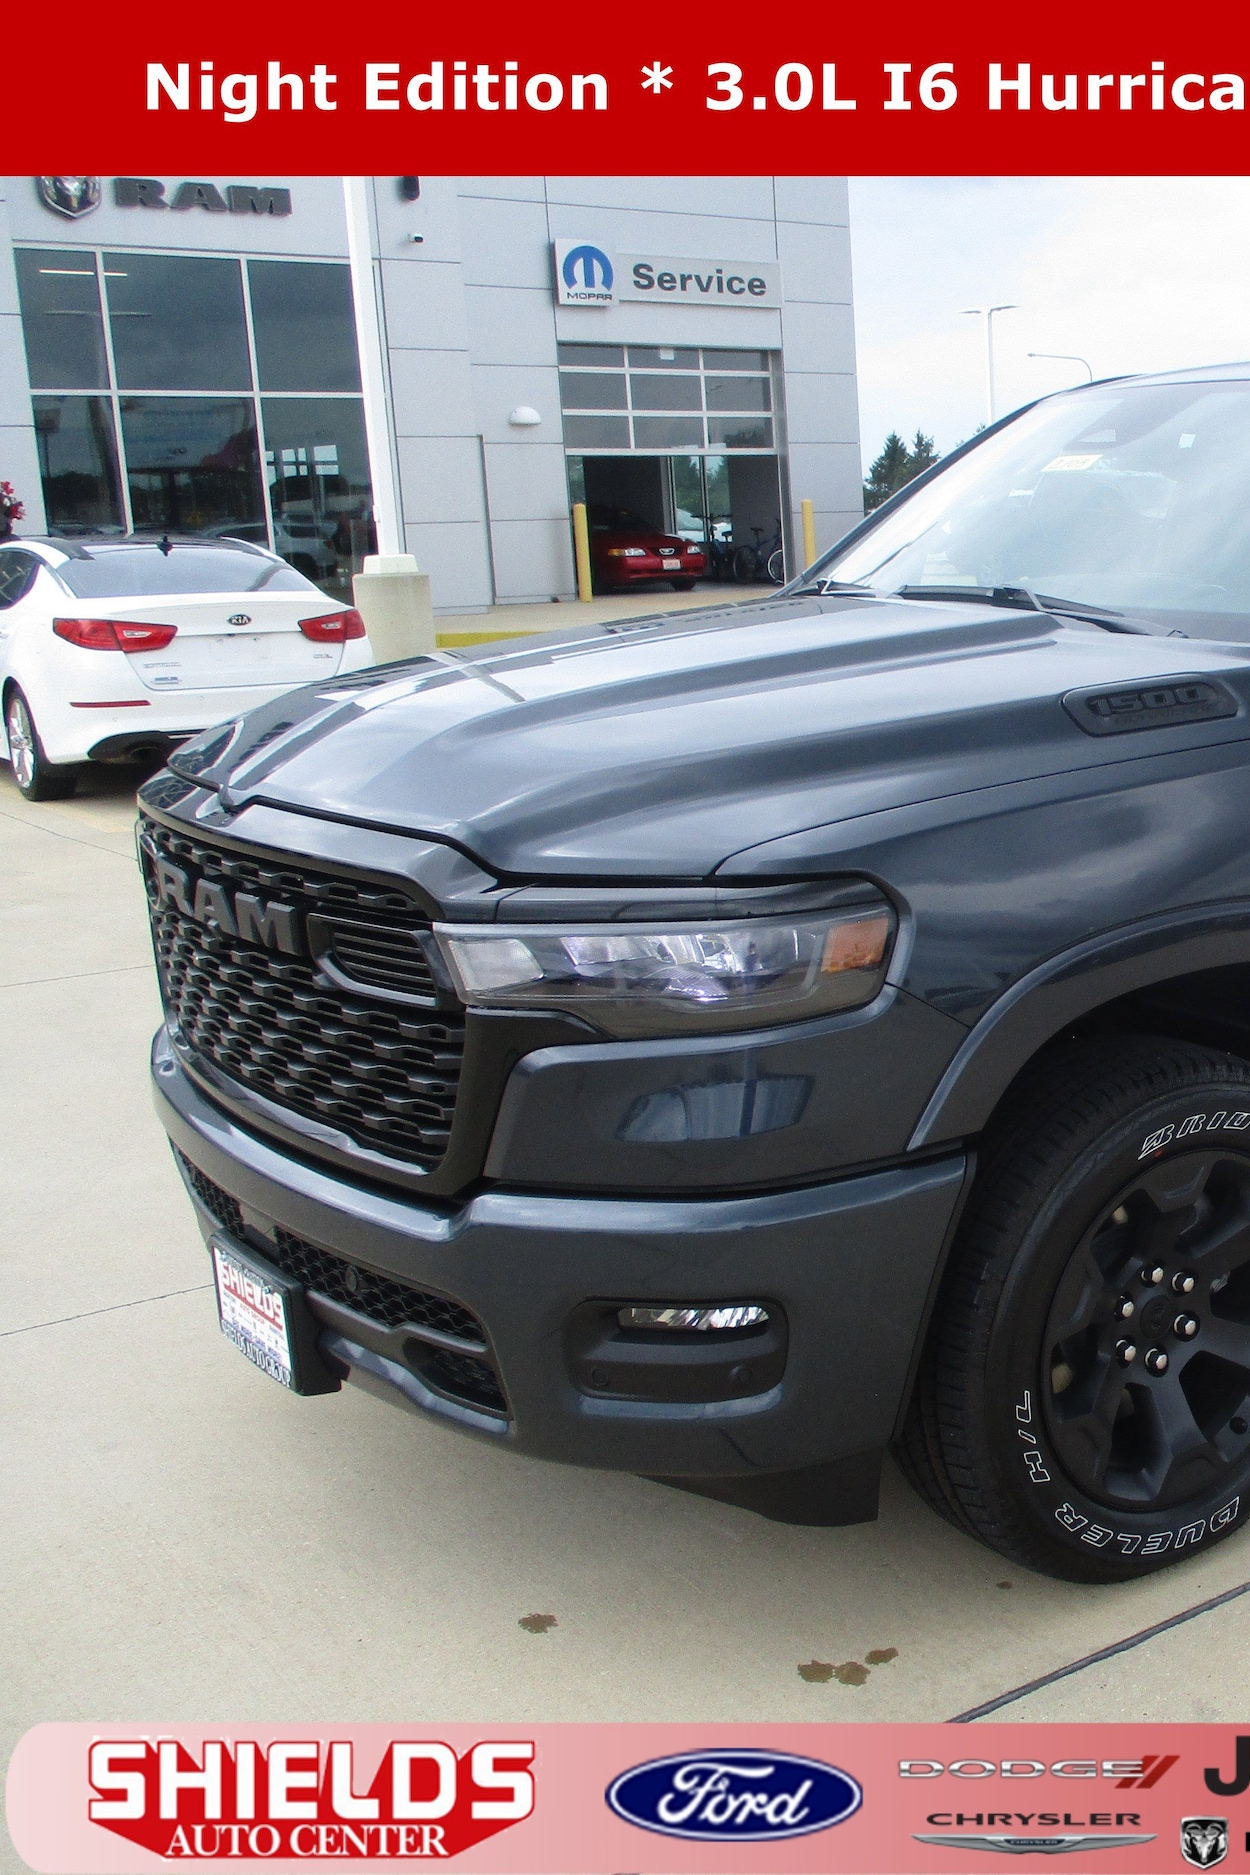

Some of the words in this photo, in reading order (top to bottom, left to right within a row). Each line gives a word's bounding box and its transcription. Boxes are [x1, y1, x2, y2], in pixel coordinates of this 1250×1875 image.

[113, 177, 293, 216] RAM
[566, 291, 613, 301] MOPAR
[632, 262, 767, 297] Service
[231, 616, 249, 624] KIA
[1087, 687, 1202, 717] 1500
[156, 855, 300, 956] RAM
[220, 1263, 283, 1322] SHIELDS
[1015, 1390, 1050, 1483] H/L
[1054, 1495, 1241, 1556] DUELER
